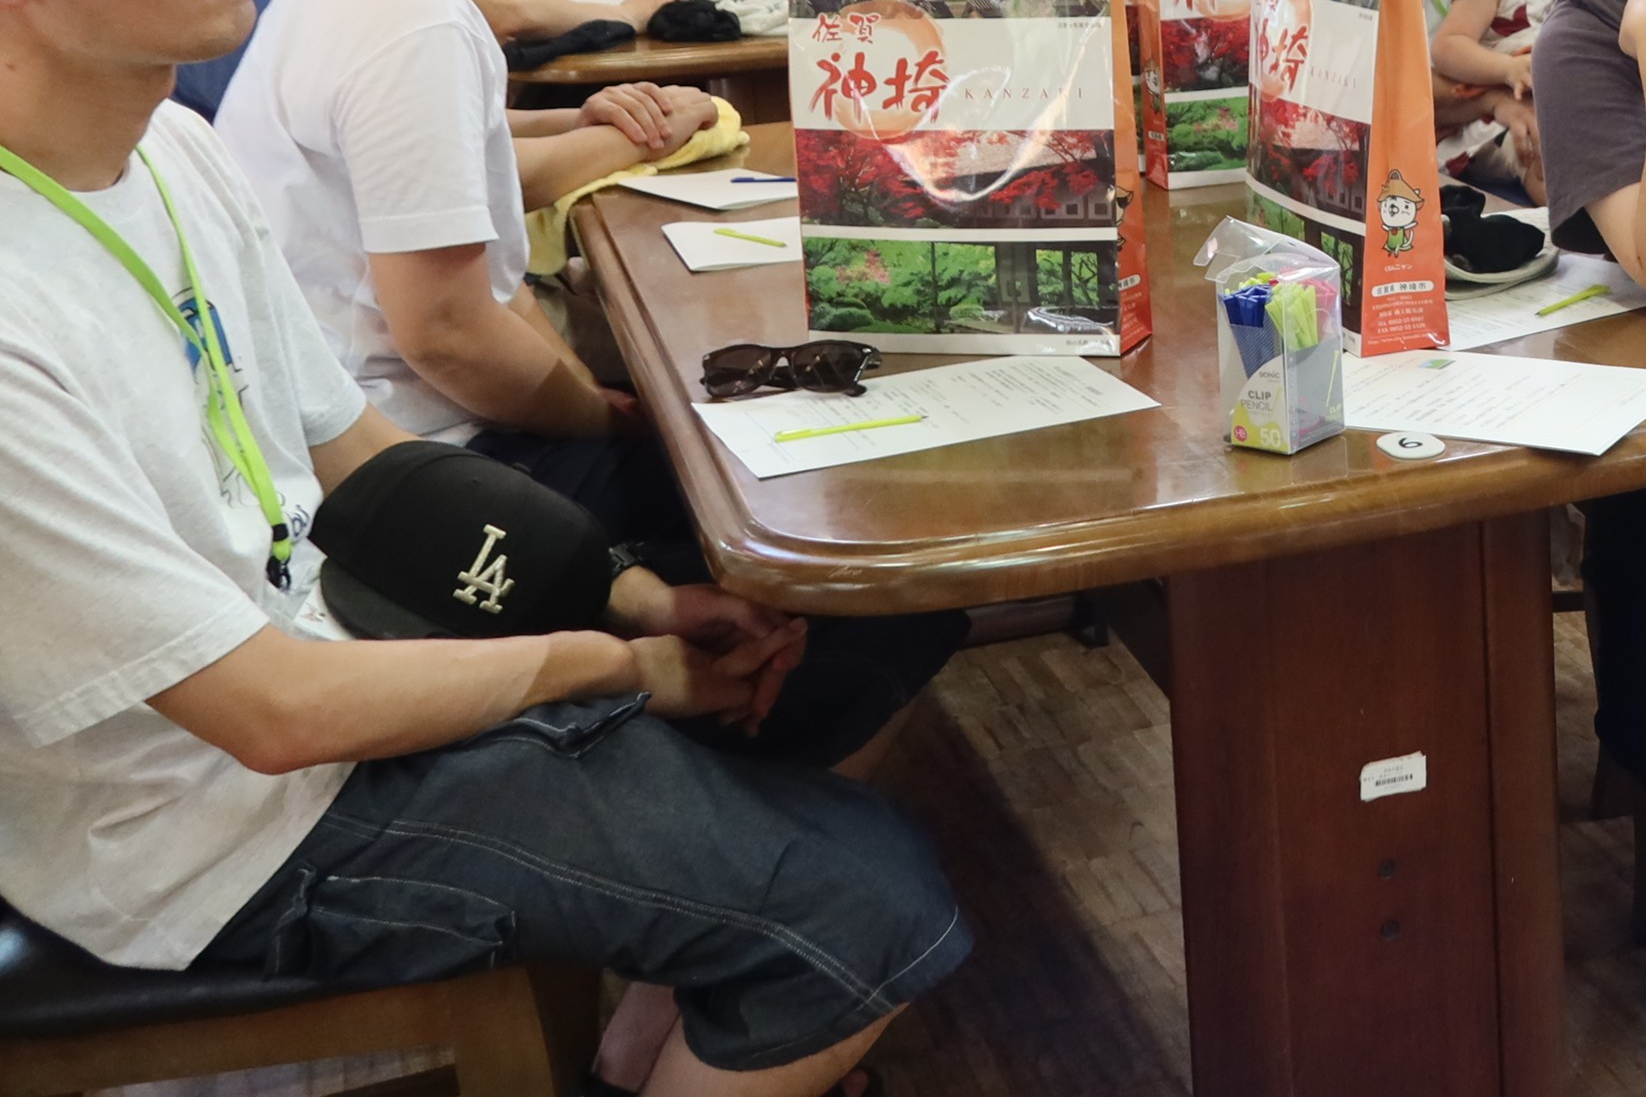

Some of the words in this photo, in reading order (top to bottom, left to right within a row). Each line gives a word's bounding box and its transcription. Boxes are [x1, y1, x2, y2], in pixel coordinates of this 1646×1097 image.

[812, 13, 880, 44] 佐賀
[1247, 389, 1272, 400] CLIP
[1259, 426, 1282, 448] 50
[452, 523, 516, 615] LA
